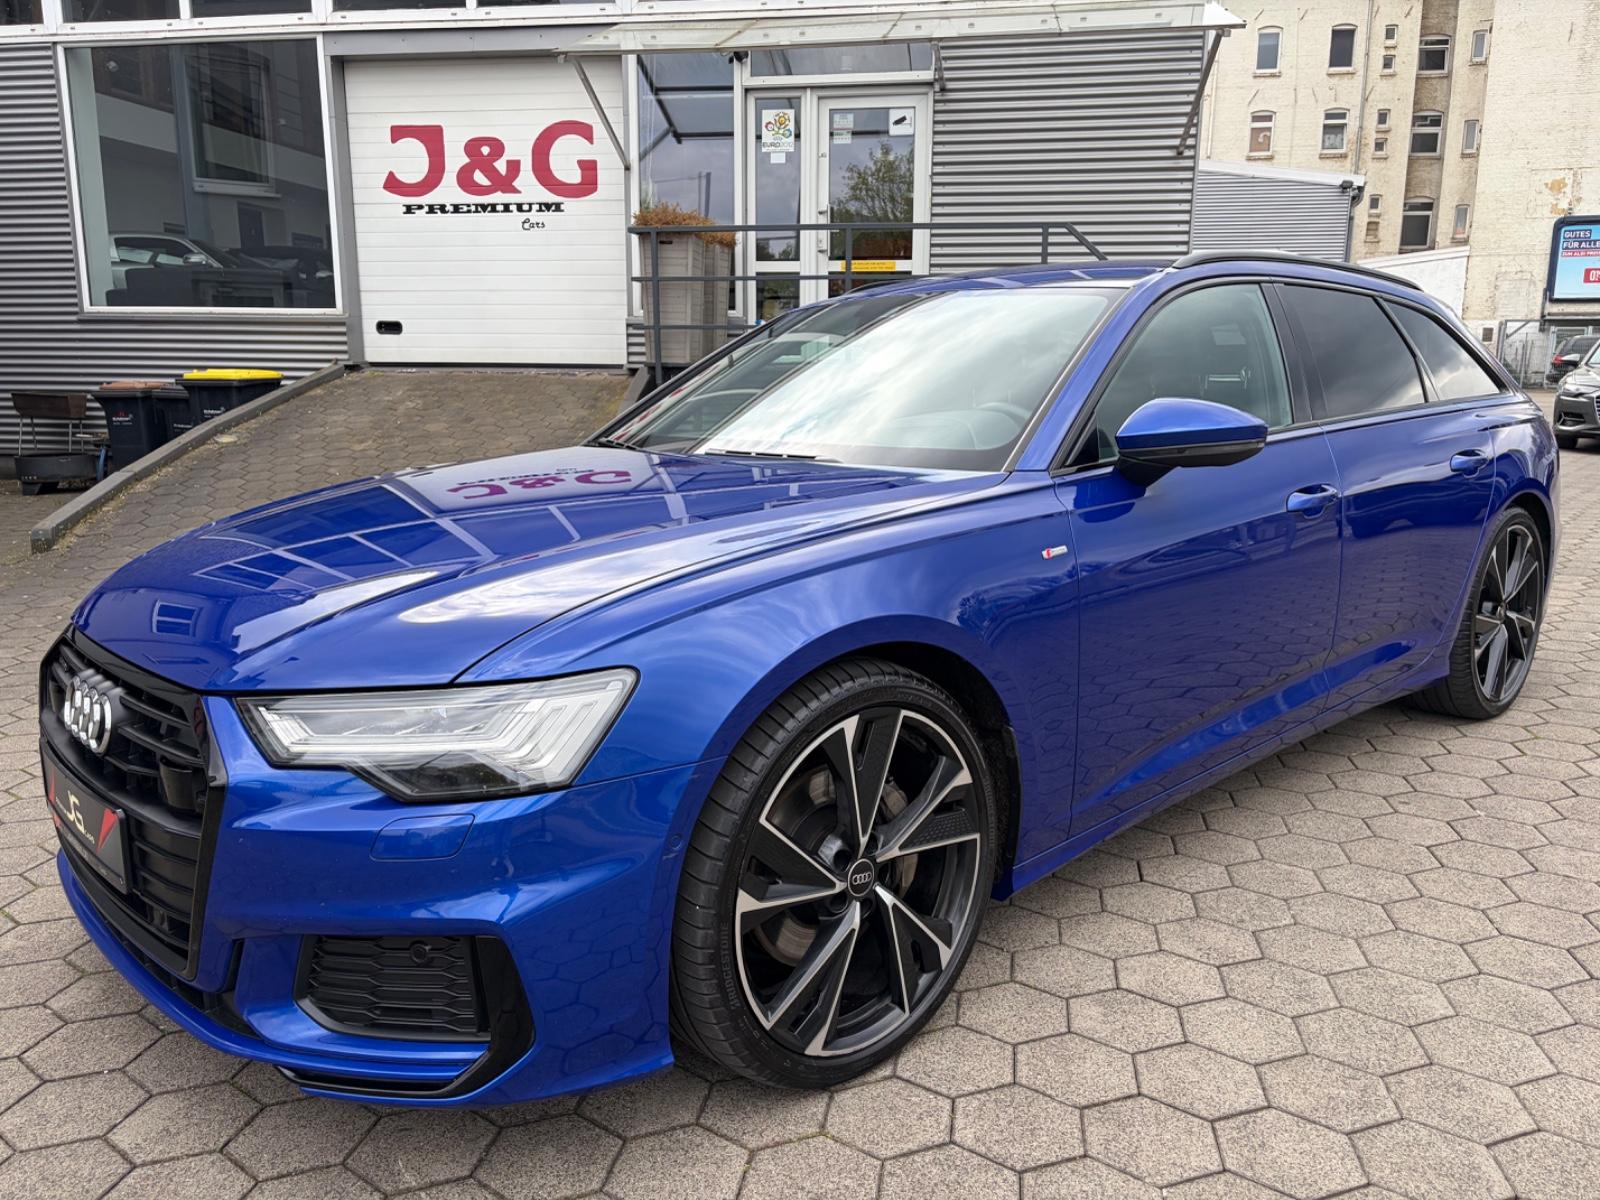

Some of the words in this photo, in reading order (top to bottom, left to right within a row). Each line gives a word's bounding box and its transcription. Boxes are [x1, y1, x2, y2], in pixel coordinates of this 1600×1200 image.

[383, 120, 598, 198] J&G
[402, 201, 565, 215] PREMIUM
[521, 217, 546, 231] Cars
[1563, 240, 1580, 249] FÜR
